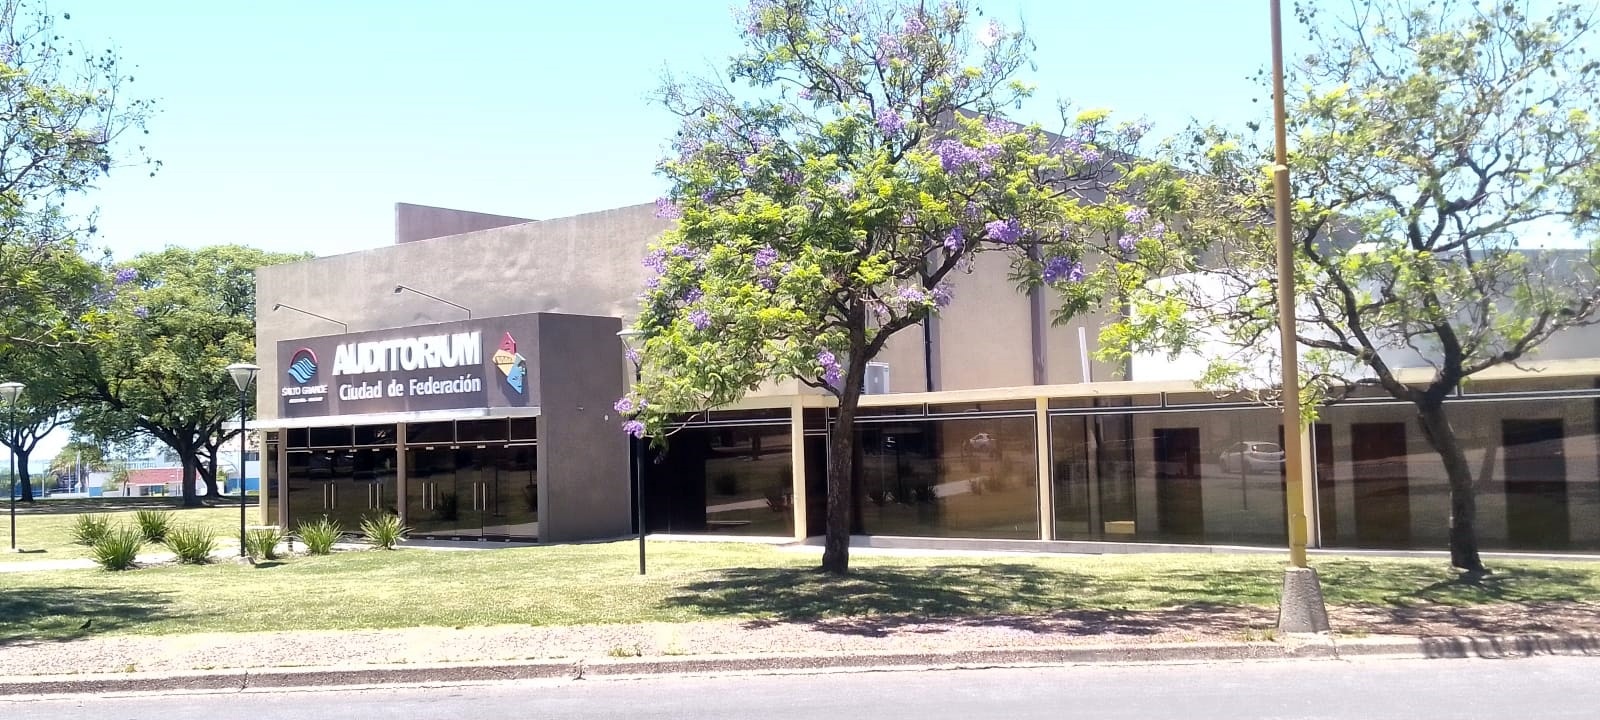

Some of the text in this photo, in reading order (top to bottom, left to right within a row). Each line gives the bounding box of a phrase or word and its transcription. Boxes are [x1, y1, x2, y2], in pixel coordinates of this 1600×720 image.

[332, 331, 482, 376] AUDITORIUM
[339, 374, 481, 401] Ciudad de Federación
